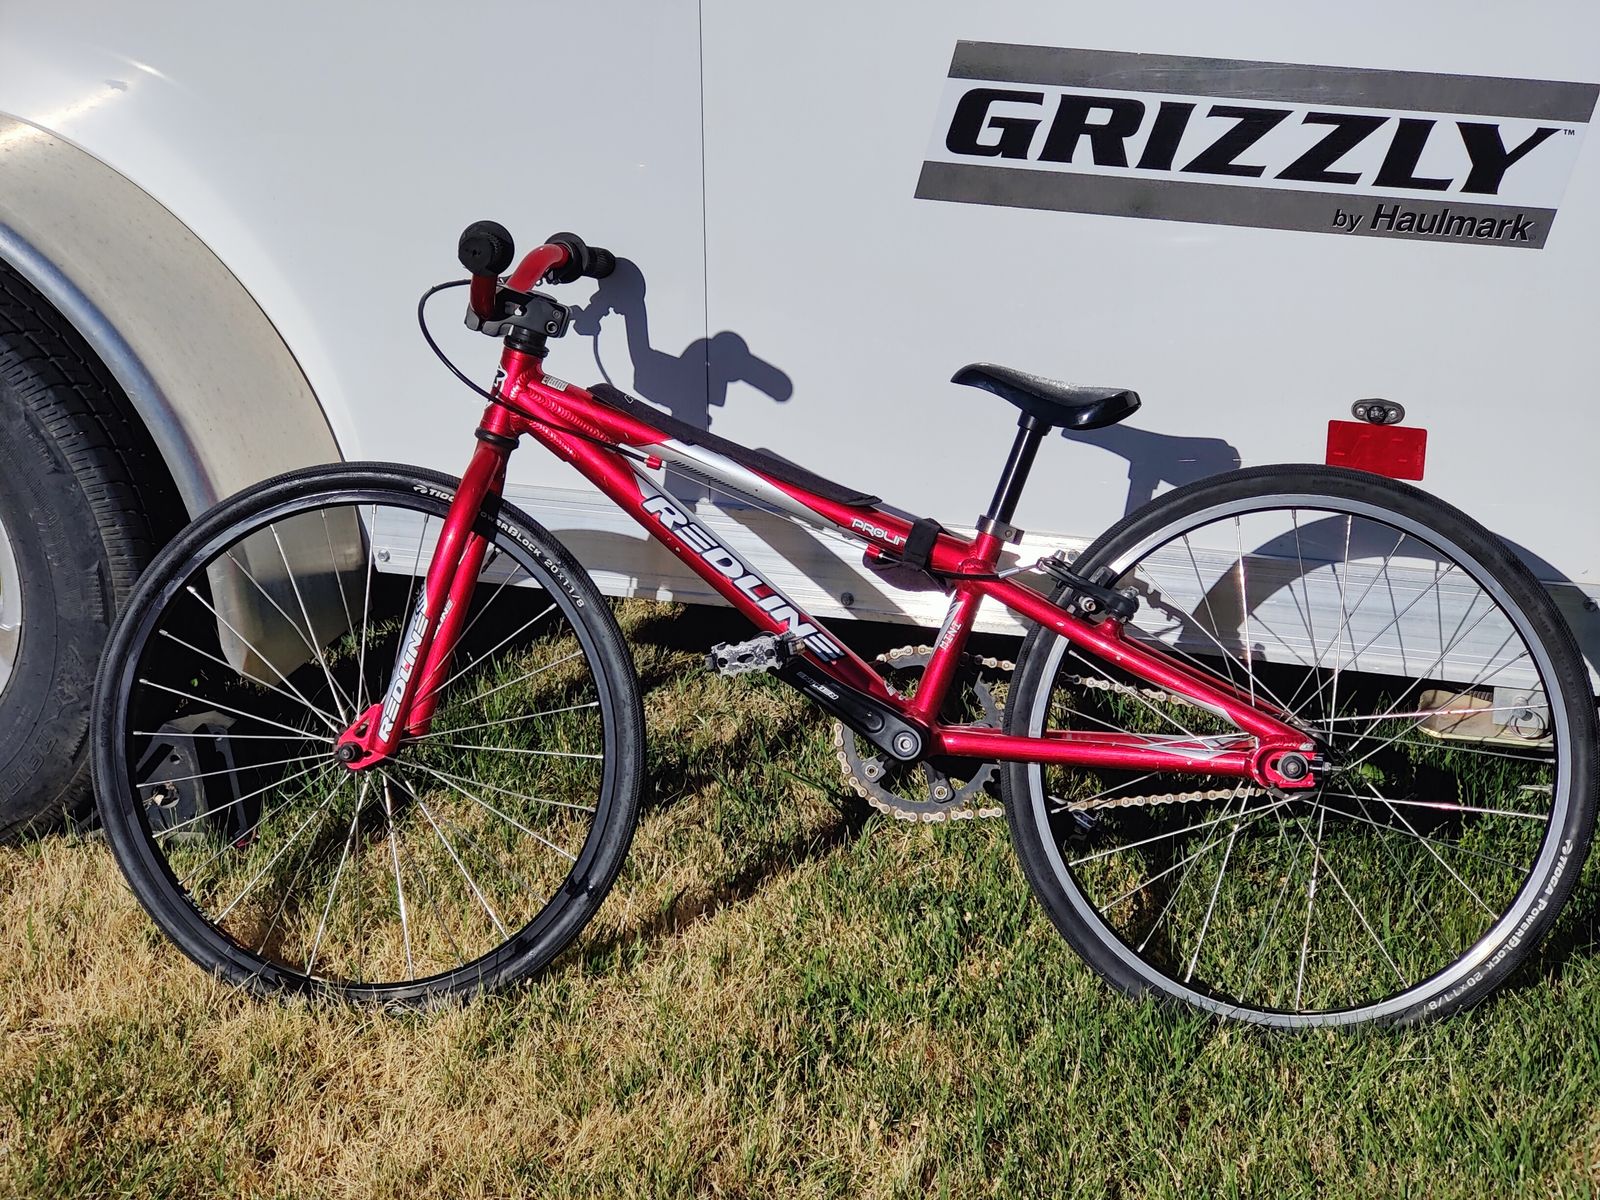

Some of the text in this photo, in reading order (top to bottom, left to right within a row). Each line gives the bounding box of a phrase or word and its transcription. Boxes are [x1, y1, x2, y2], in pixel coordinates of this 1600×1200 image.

[945, 88, 1562, 195] GRIZZLY
[1332, 204, 1536, 242] by Haulmark
[429, 488, 455, 503] TIOG
[852, 518, 908, 546] PROLIN
[642, 495, 846, 662] REDLINE
[940, 621, 962, 650] MINI
[378, 611, 430, 744] REDLINE
[1545, 855, 1569, 895] TIOGA
